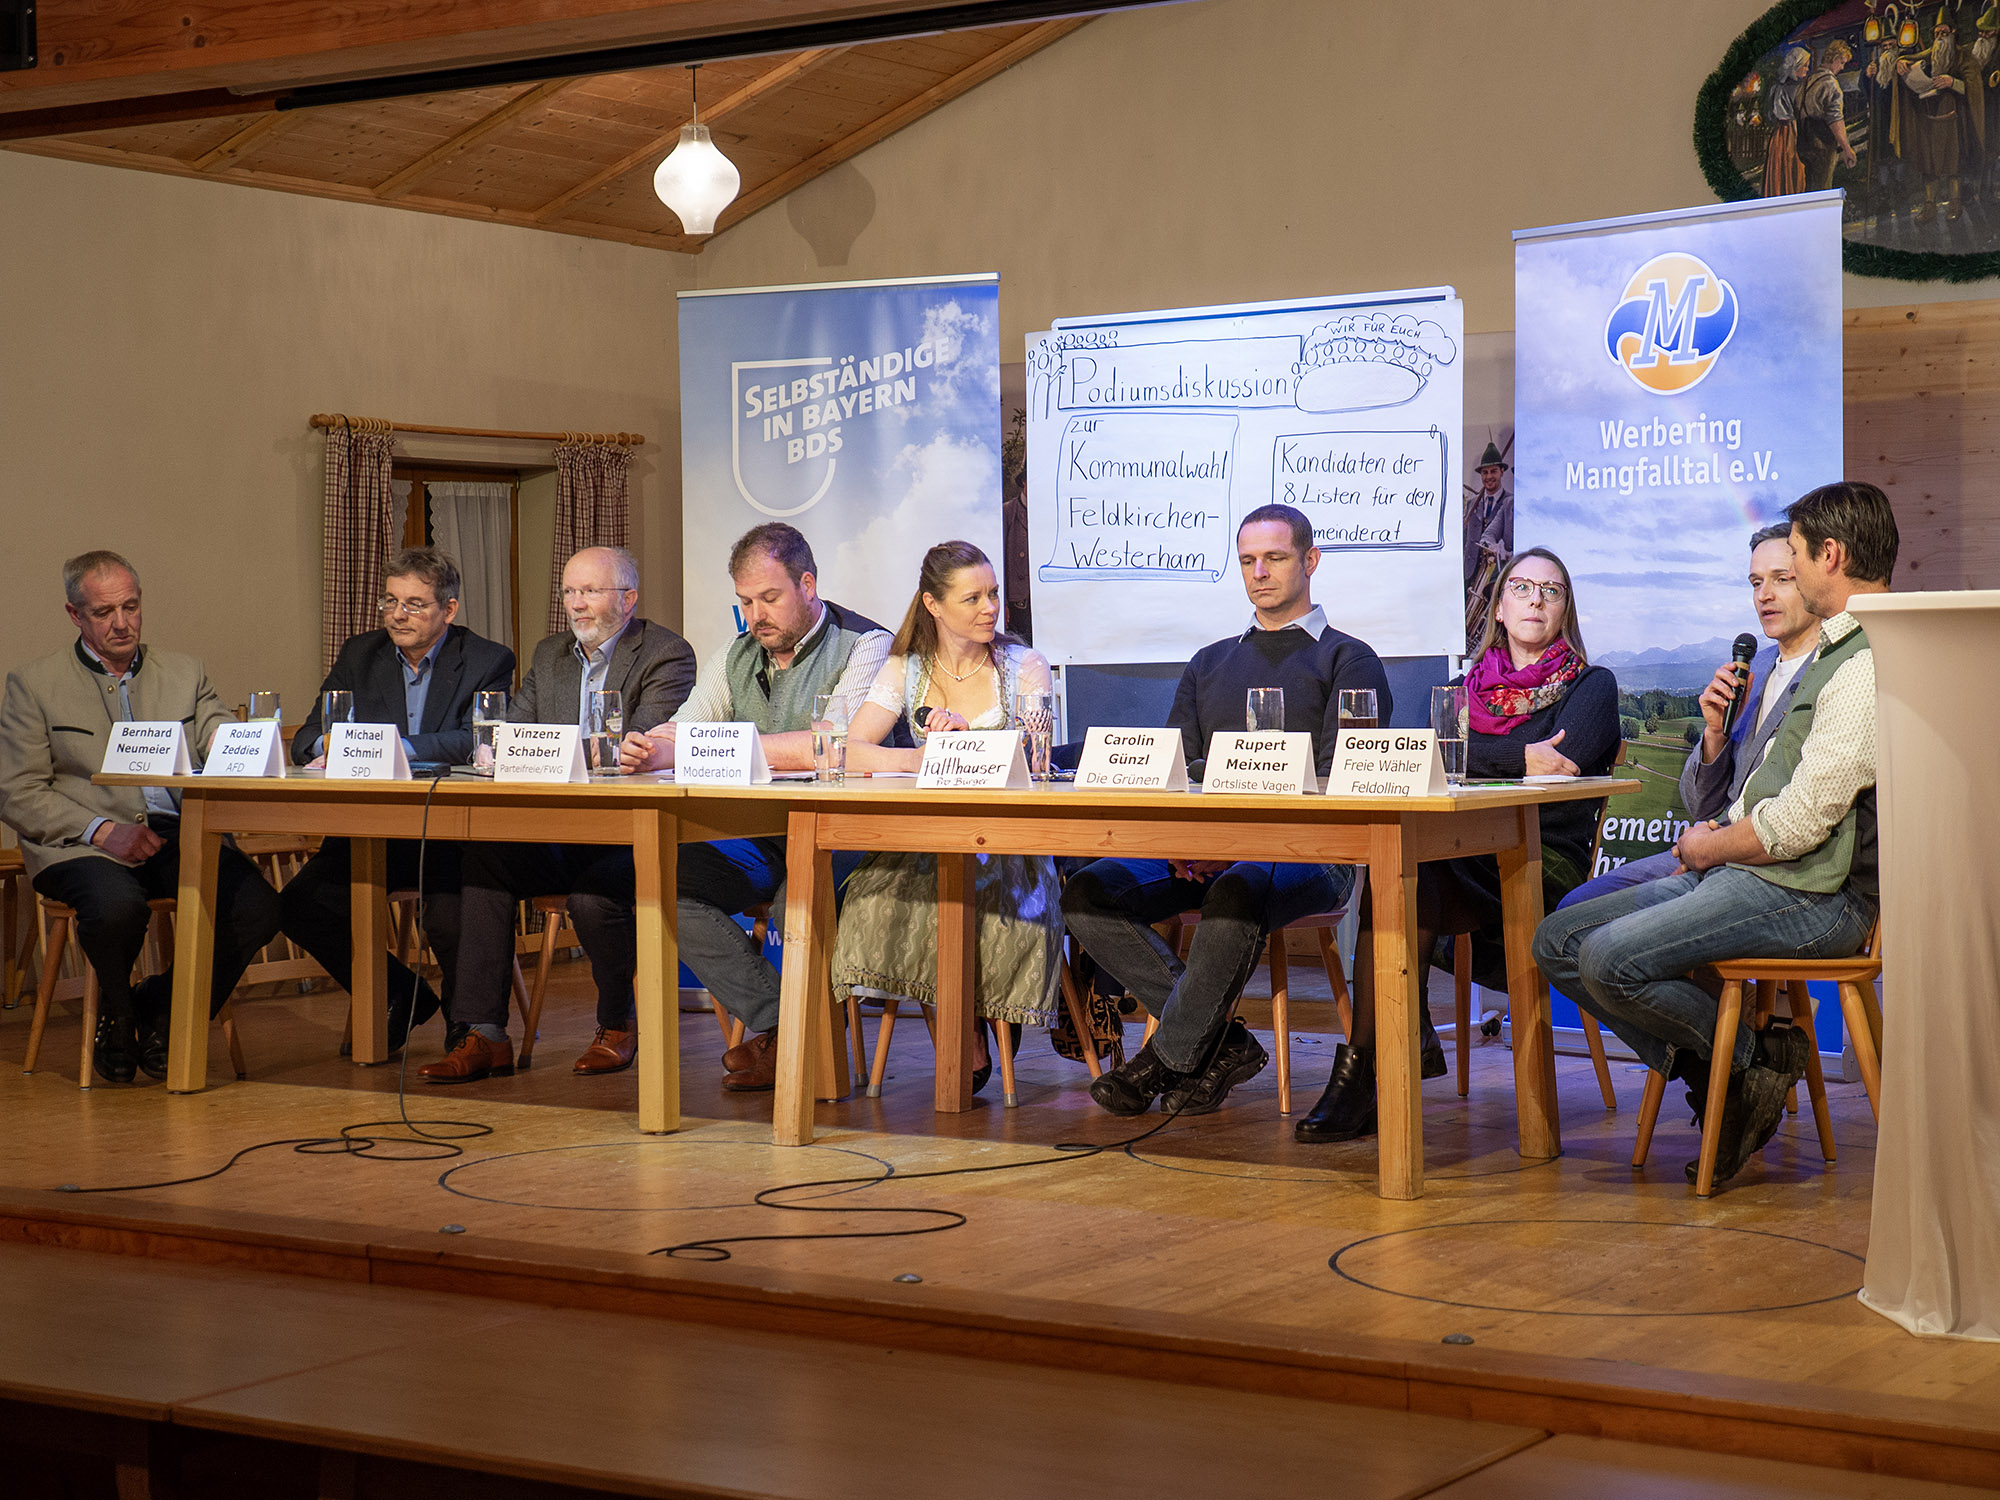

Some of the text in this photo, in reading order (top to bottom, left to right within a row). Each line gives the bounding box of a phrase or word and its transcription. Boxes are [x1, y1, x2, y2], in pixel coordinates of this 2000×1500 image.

[1629, 274, 1708, 369] M
[1330, 322, 1421, 338] WIR FÜR EUCH
[745, 337, 950, 418] SELBSTÄNDIGE
[1072, 357, 1287, 404] Podiumsdiskussion
[763, 376, 916, 442] IN BAYERN
[1070, 420, 1104, 433] zur
[1600, 413, 1741, 449] Werbering
[787, 426, 843, 464] BDS
[1069, 440, 1228, 481] Kommunalwahl
[1282, 442, 1424, 475] Kandidaten der
[1565, 450, 1779, 495] Mangfalltal e.V.
[1283, 482, 1434, 507] 8 Listen für den
[1070, 497, 1219, 528] Feldkirchen-
[1313, 520, 1401, 542] meinderat
[1070, 537, 1205, 571] Westerham
[121, 727, 172, 739] Bernhard
[229, 728, 262, 740] Roland
[345, 729, 384, 741] Michael
[513, 727, 561, 740] Vinzenz
[689, 727, 739, 739] Caroline
[1104, 733, 1155, 747] Carolin
[116, 743, 171, 755] Neumeier
[222, 743, 260, 756] Zeddies
[691, 745, 735, 757] Deinert
[936, 736, 986, 752] Franz
[1234, 738, 1287, 753] Rupert
[1345, 736, 1427, 753] Georg Glas
[342, 746, 383, 759] Schmirl
[507, 745, 560, 758] Schaberl
[128, 760, 151, 772] CSU
[1108, 753, 1150, 766] Günzl
[1225, 758, 1288, 772] Meixner
[1343, 758, 1422, 773] Freie Wähler
[225, 762, 245, 773] AFD
[351, 766, 371, 778] SPD
[500, 763, 563, 775] Parteifreie/FWG
[683, 765, 742, 778] Moderation
[1086, 772, 1159, 786] Die Grünen
[1212, 778, 1296, 793] Ortsliste Vagen
[1351, 780, 1410, 797] Feldolling
